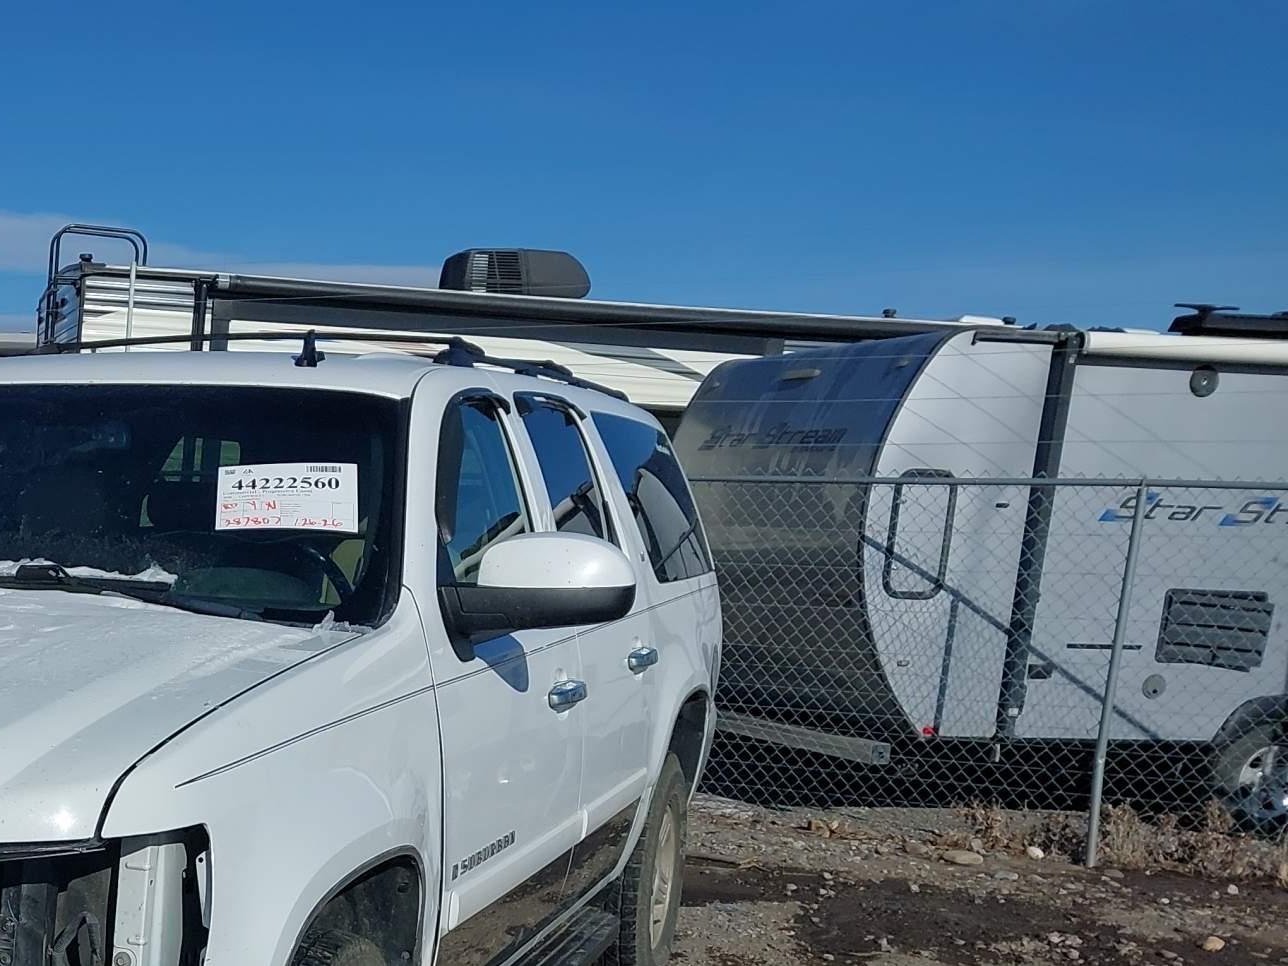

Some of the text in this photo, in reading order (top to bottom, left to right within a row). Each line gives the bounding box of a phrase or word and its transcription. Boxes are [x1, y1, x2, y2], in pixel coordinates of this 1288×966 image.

[231, 477, 340, 491] 44222560
[1100, 491, 1288, 528] Star St
